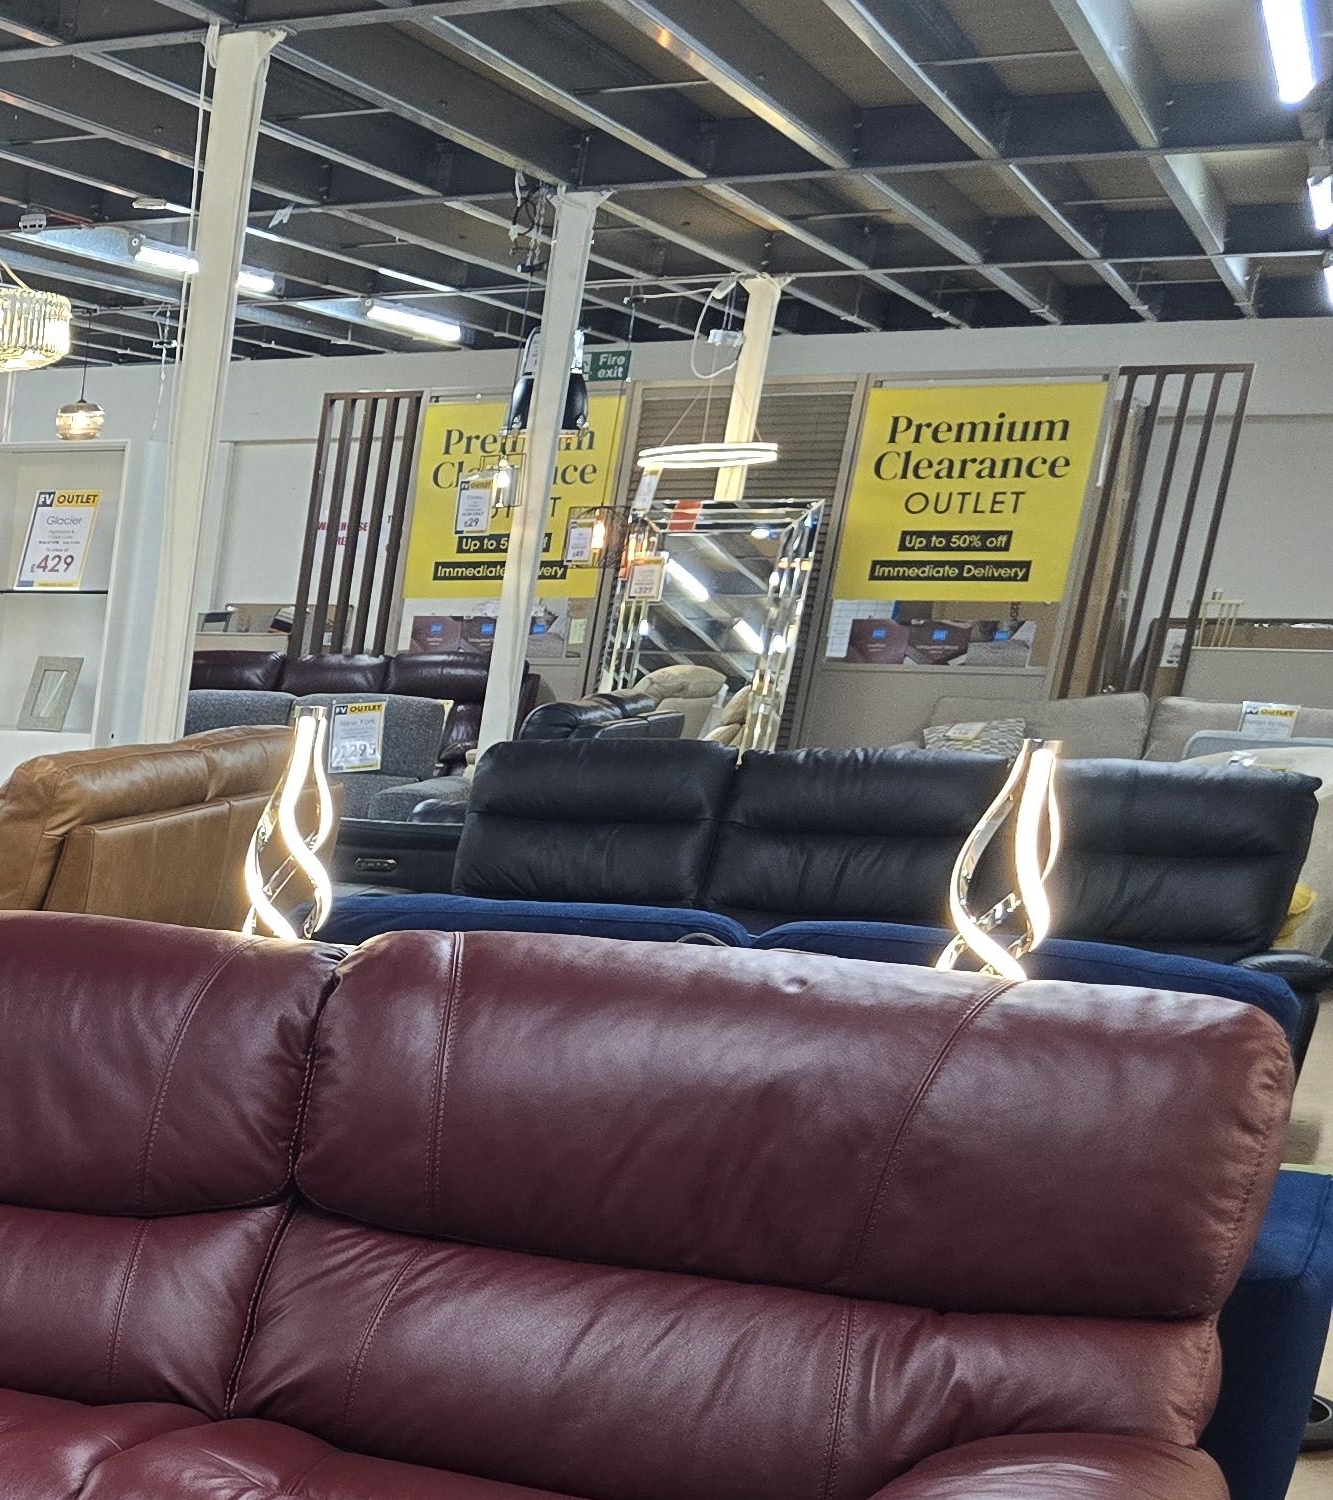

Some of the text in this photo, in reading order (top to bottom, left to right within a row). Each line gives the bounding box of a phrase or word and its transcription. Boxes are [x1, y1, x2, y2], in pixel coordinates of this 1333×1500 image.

[598, 353, 626, 366] Fire
[597, 366, 624, 379] exit
[887, 412, 1070, 444] Premium
[873, 450, 1072, 481] Clearance
[57, 494, 99, 505] OUTLET
[904, 491, 1026, 515] OUTLET
[46, 515, 83, 526] Glacier
[461, 538, 480, 552] Up
[483, 538, 496, 549] to
[905, 534, 1007, 550] Up to 50% off
[30, 554, 75, 573] £429
[875, 564, 1027, 581] Immediate Delivery
[349, 704, 382, 713] OUTLET
